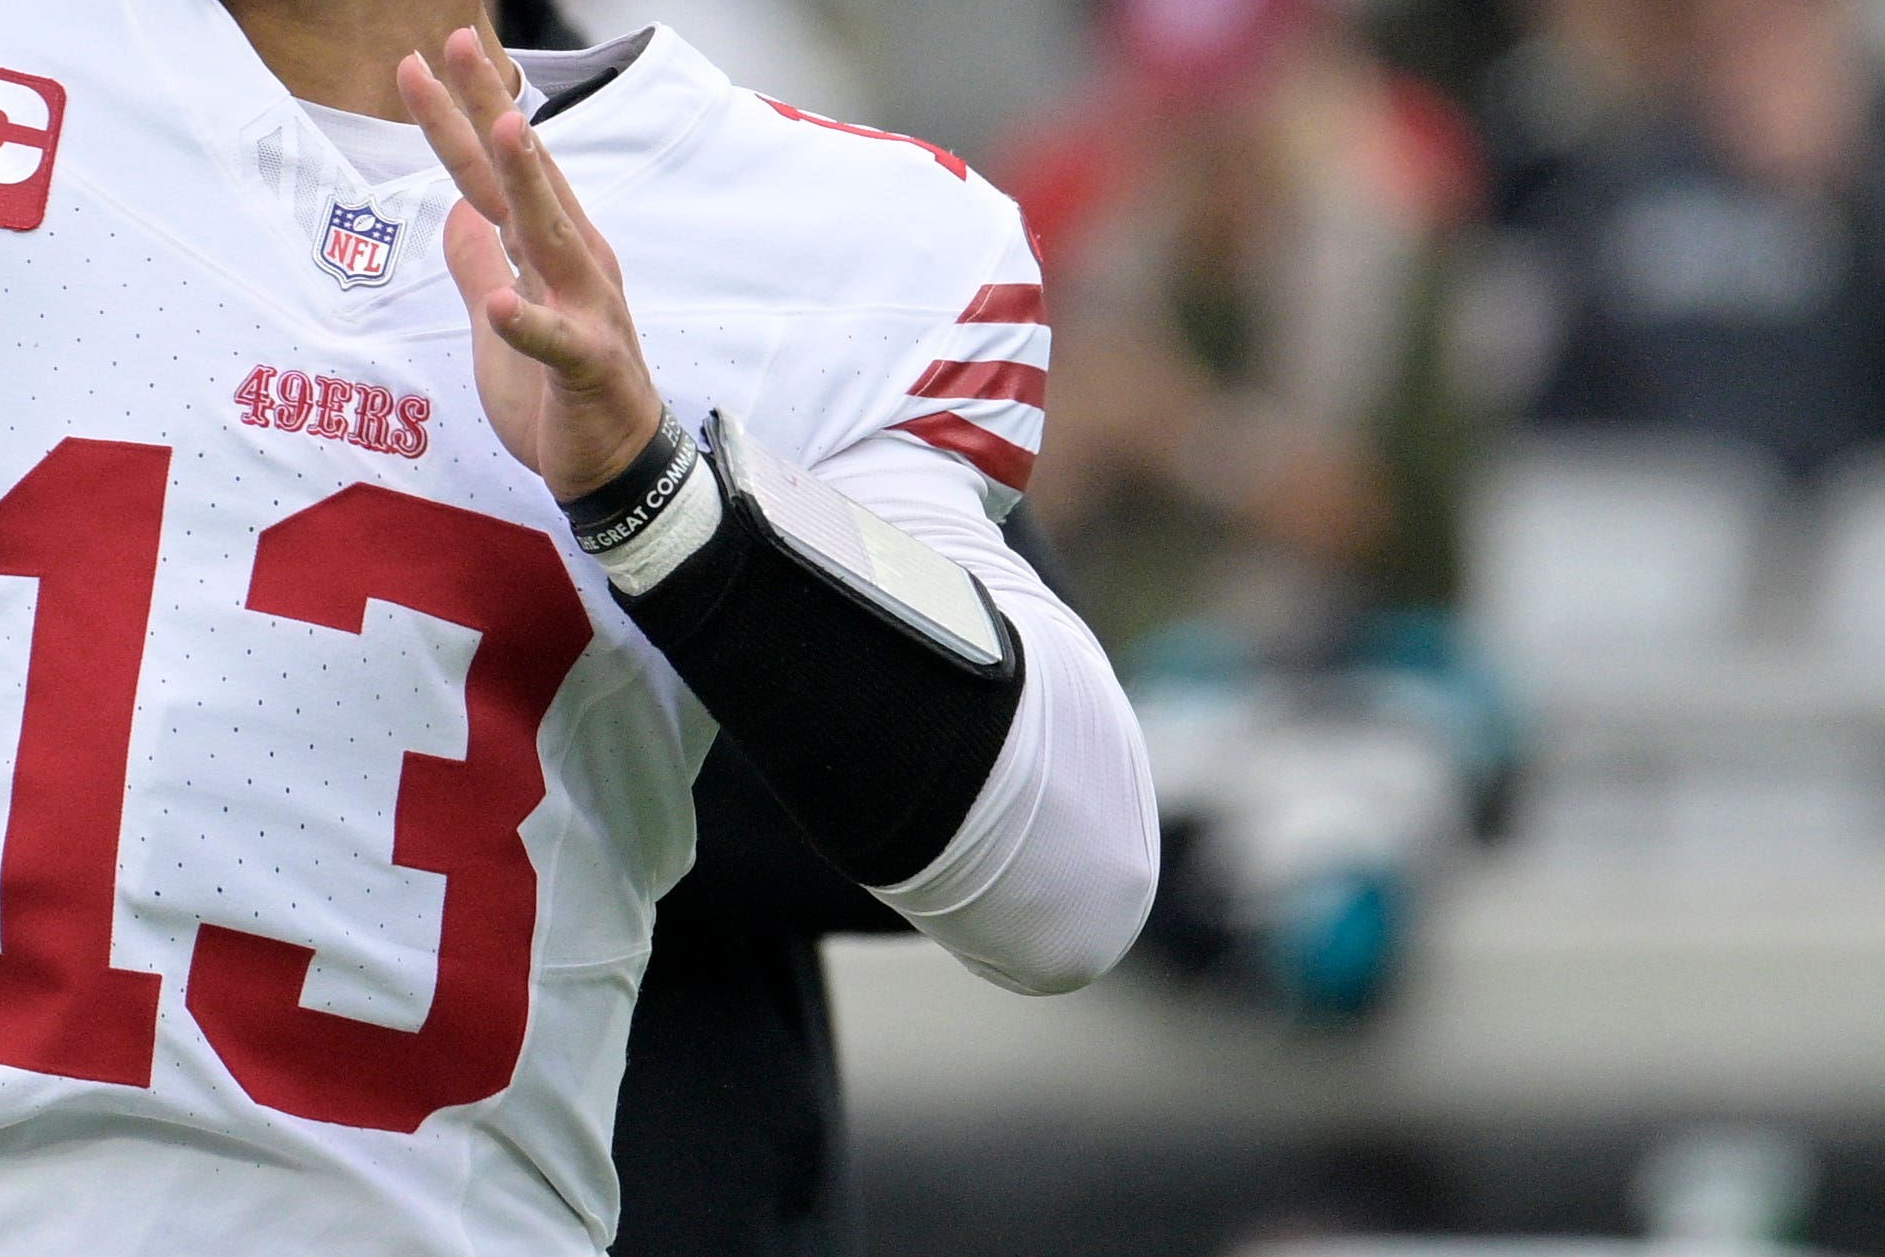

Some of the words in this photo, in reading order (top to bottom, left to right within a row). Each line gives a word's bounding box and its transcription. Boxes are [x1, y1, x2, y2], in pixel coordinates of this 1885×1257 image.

[326, 229, 381, 273] NFL
[234, 364, 430, 459] 49ERS
[597, 505, 649, 546] GREAT
